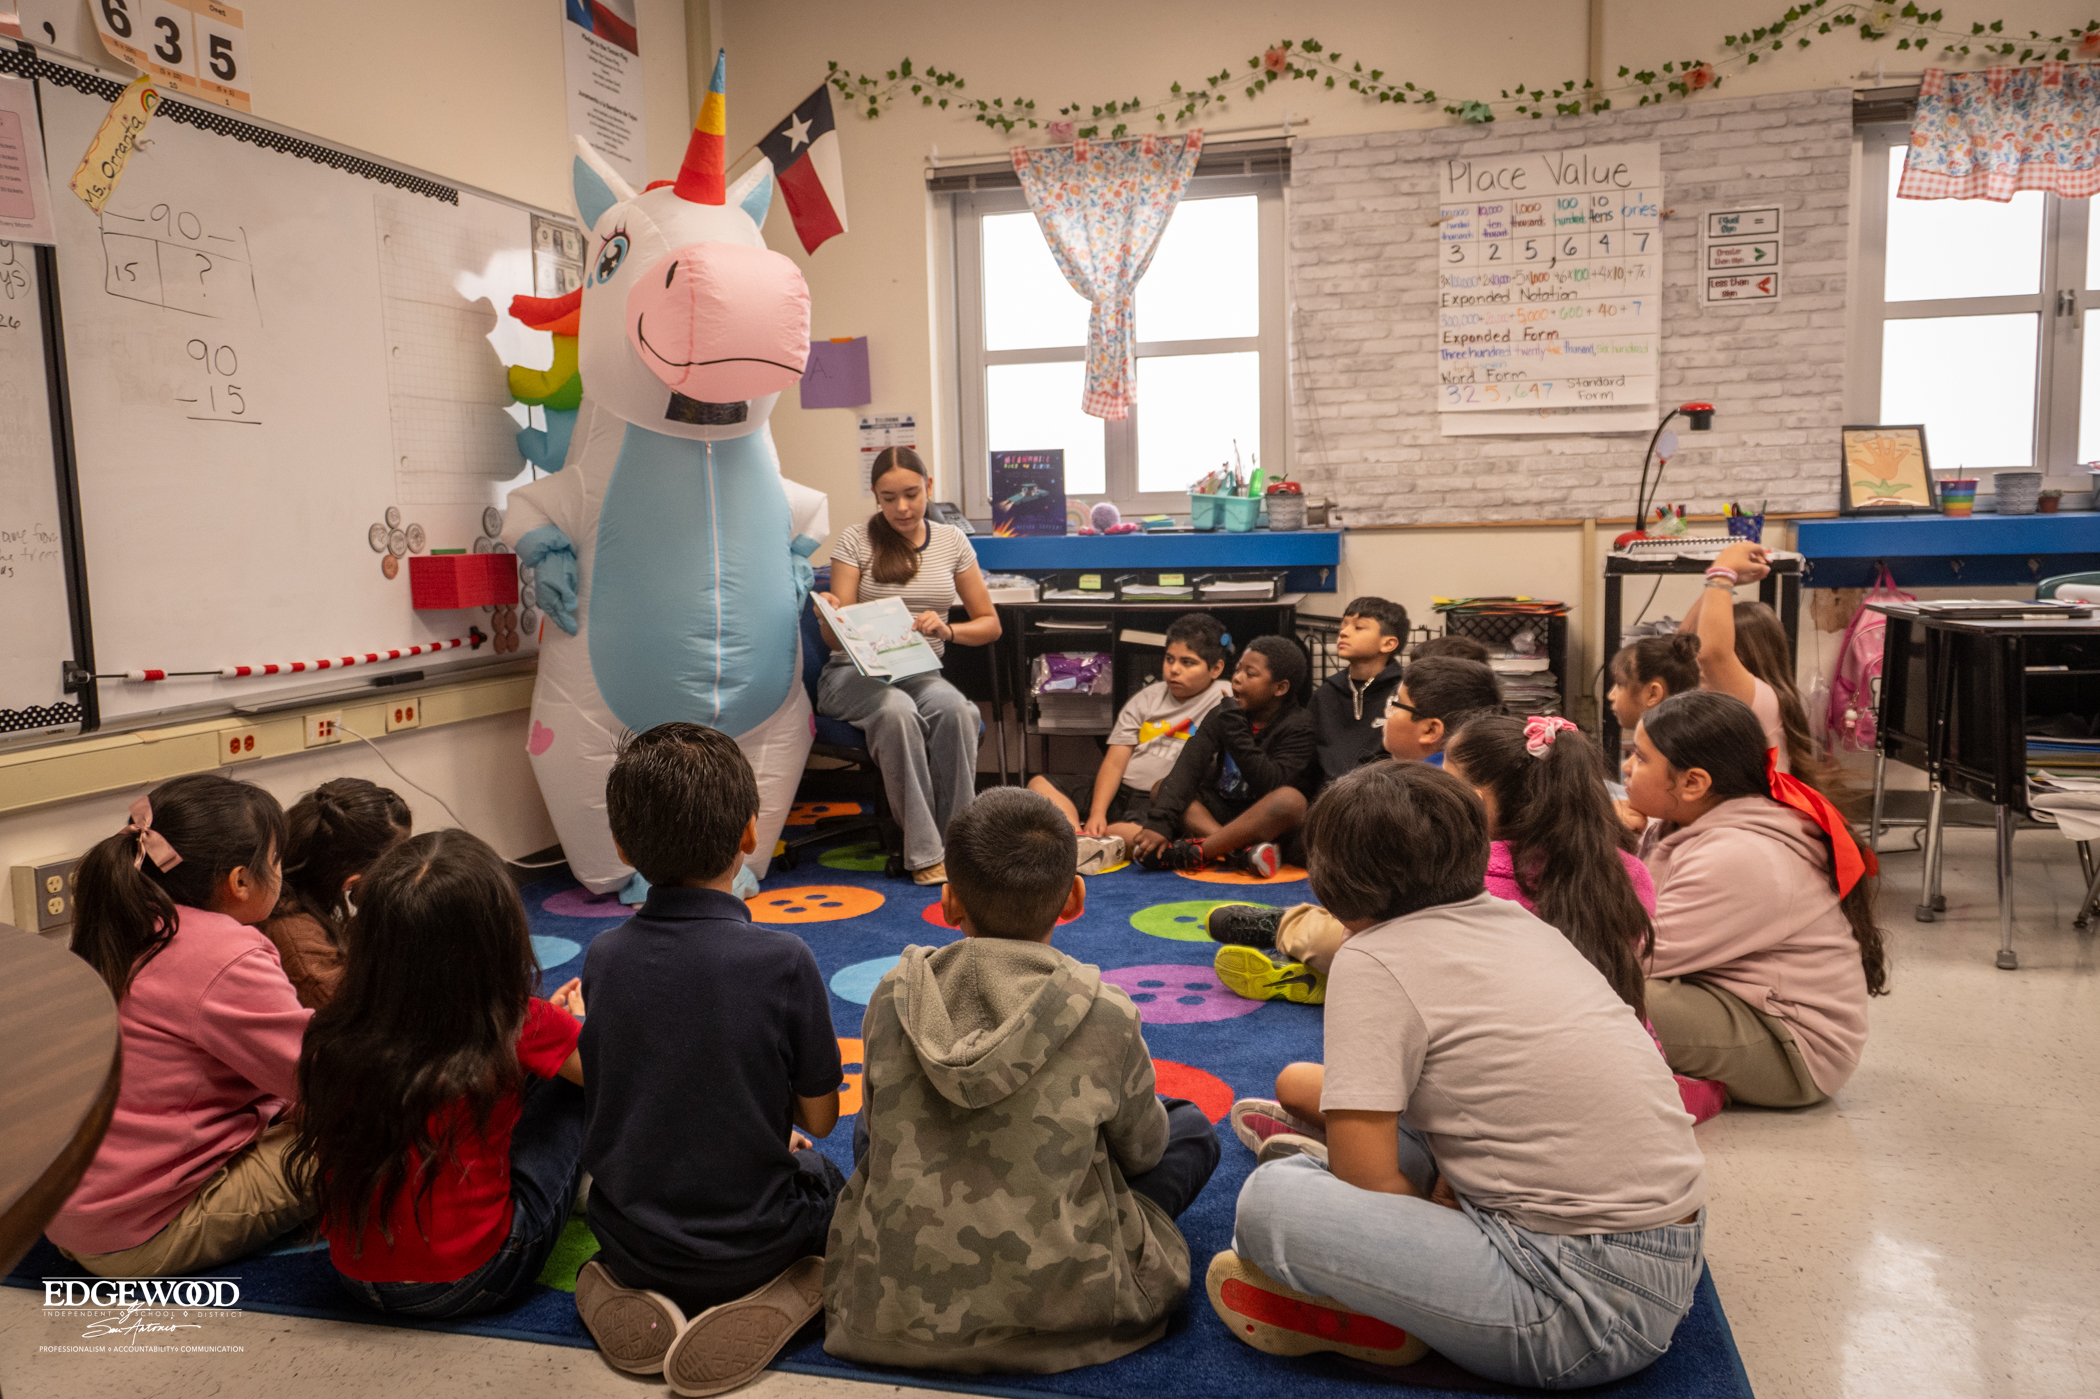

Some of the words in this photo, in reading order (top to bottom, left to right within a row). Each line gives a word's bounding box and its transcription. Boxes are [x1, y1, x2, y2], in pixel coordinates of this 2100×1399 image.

[209, 5, 226, 17] Ones
[101, 0, 132, 38] 6
[154, 16, 182, 64] 3
[209, 34, 236, 81] 5
[1448, 160, 1527, 194] Place
[1542, 151, 1632, 188] Value
[85, 185, 106, 209] Ms.
[1478, 205, 1503, 217] 10,000
[1515, 202, 1542, 216] 1,000
[1557, 197, 1578, 210] 100
[1592, 196, 1609, 207] 10
[151, 203, 202, 240] 90
[1589, 208, 1614, 223] tens
[1621, 204, 1658, 218] ones
[1447, 244, 1465, 263] 3
[1489, 243, 1502, 260] 2
[1525, 239, 1538, 260] 5
[1563, 237, 1578, 256] 6
[1599, 234, 1610, 254] 4
[1633, 232, 1650, 252] 7
[115, 261, 138, 282] 15
[1730, 277, 1750, 287] than
[1442, 288, 1512, 308] Expanded
[1520, 285, 1578, 302] Notation
[1517, 308, 1549, 325] 5,000
[1560, 306, 1583, 320] 600
[1598, 303, 1618, 318] 40
[1632, 301, 1642, 316] 7
[1443, 328, 1511, 347] Expanded
[1523, 326, 1559, 342] Form
[187, 338, 238, 377] 90
[1441, 349, 1468, 360] Three
[1468, 346, 1512, 358] hundred
[1611, 340, 1648, 354] hundred
[1441, 370, 1476, 384] Word
[1486, 369, 1527, 382] Form
[1566, 375, 1625, 389] Standard
[1578, 390, 1614, 400] Form
